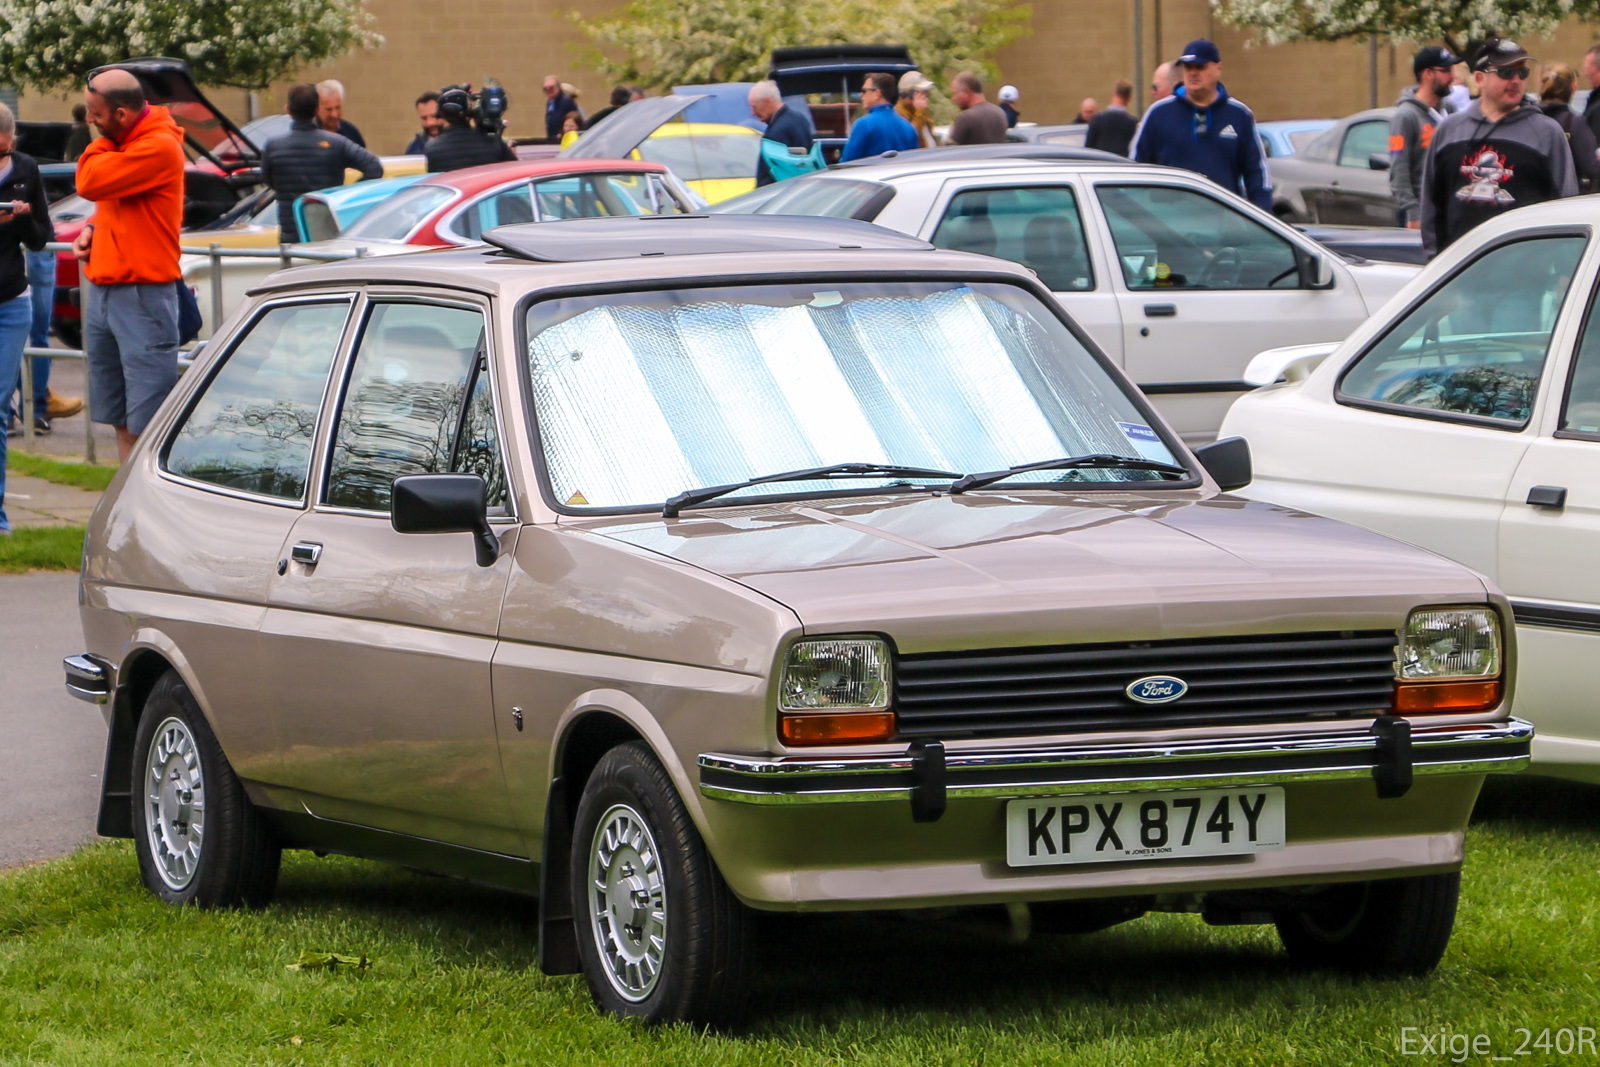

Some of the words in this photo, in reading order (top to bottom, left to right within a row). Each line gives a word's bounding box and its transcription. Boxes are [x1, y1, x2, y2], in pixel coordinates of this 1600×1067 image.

[1141, 681, 1174, 697] Ford
[1027, 802, 1124, 857] KPX
[1139, 793, 1267, 849] 874Y
